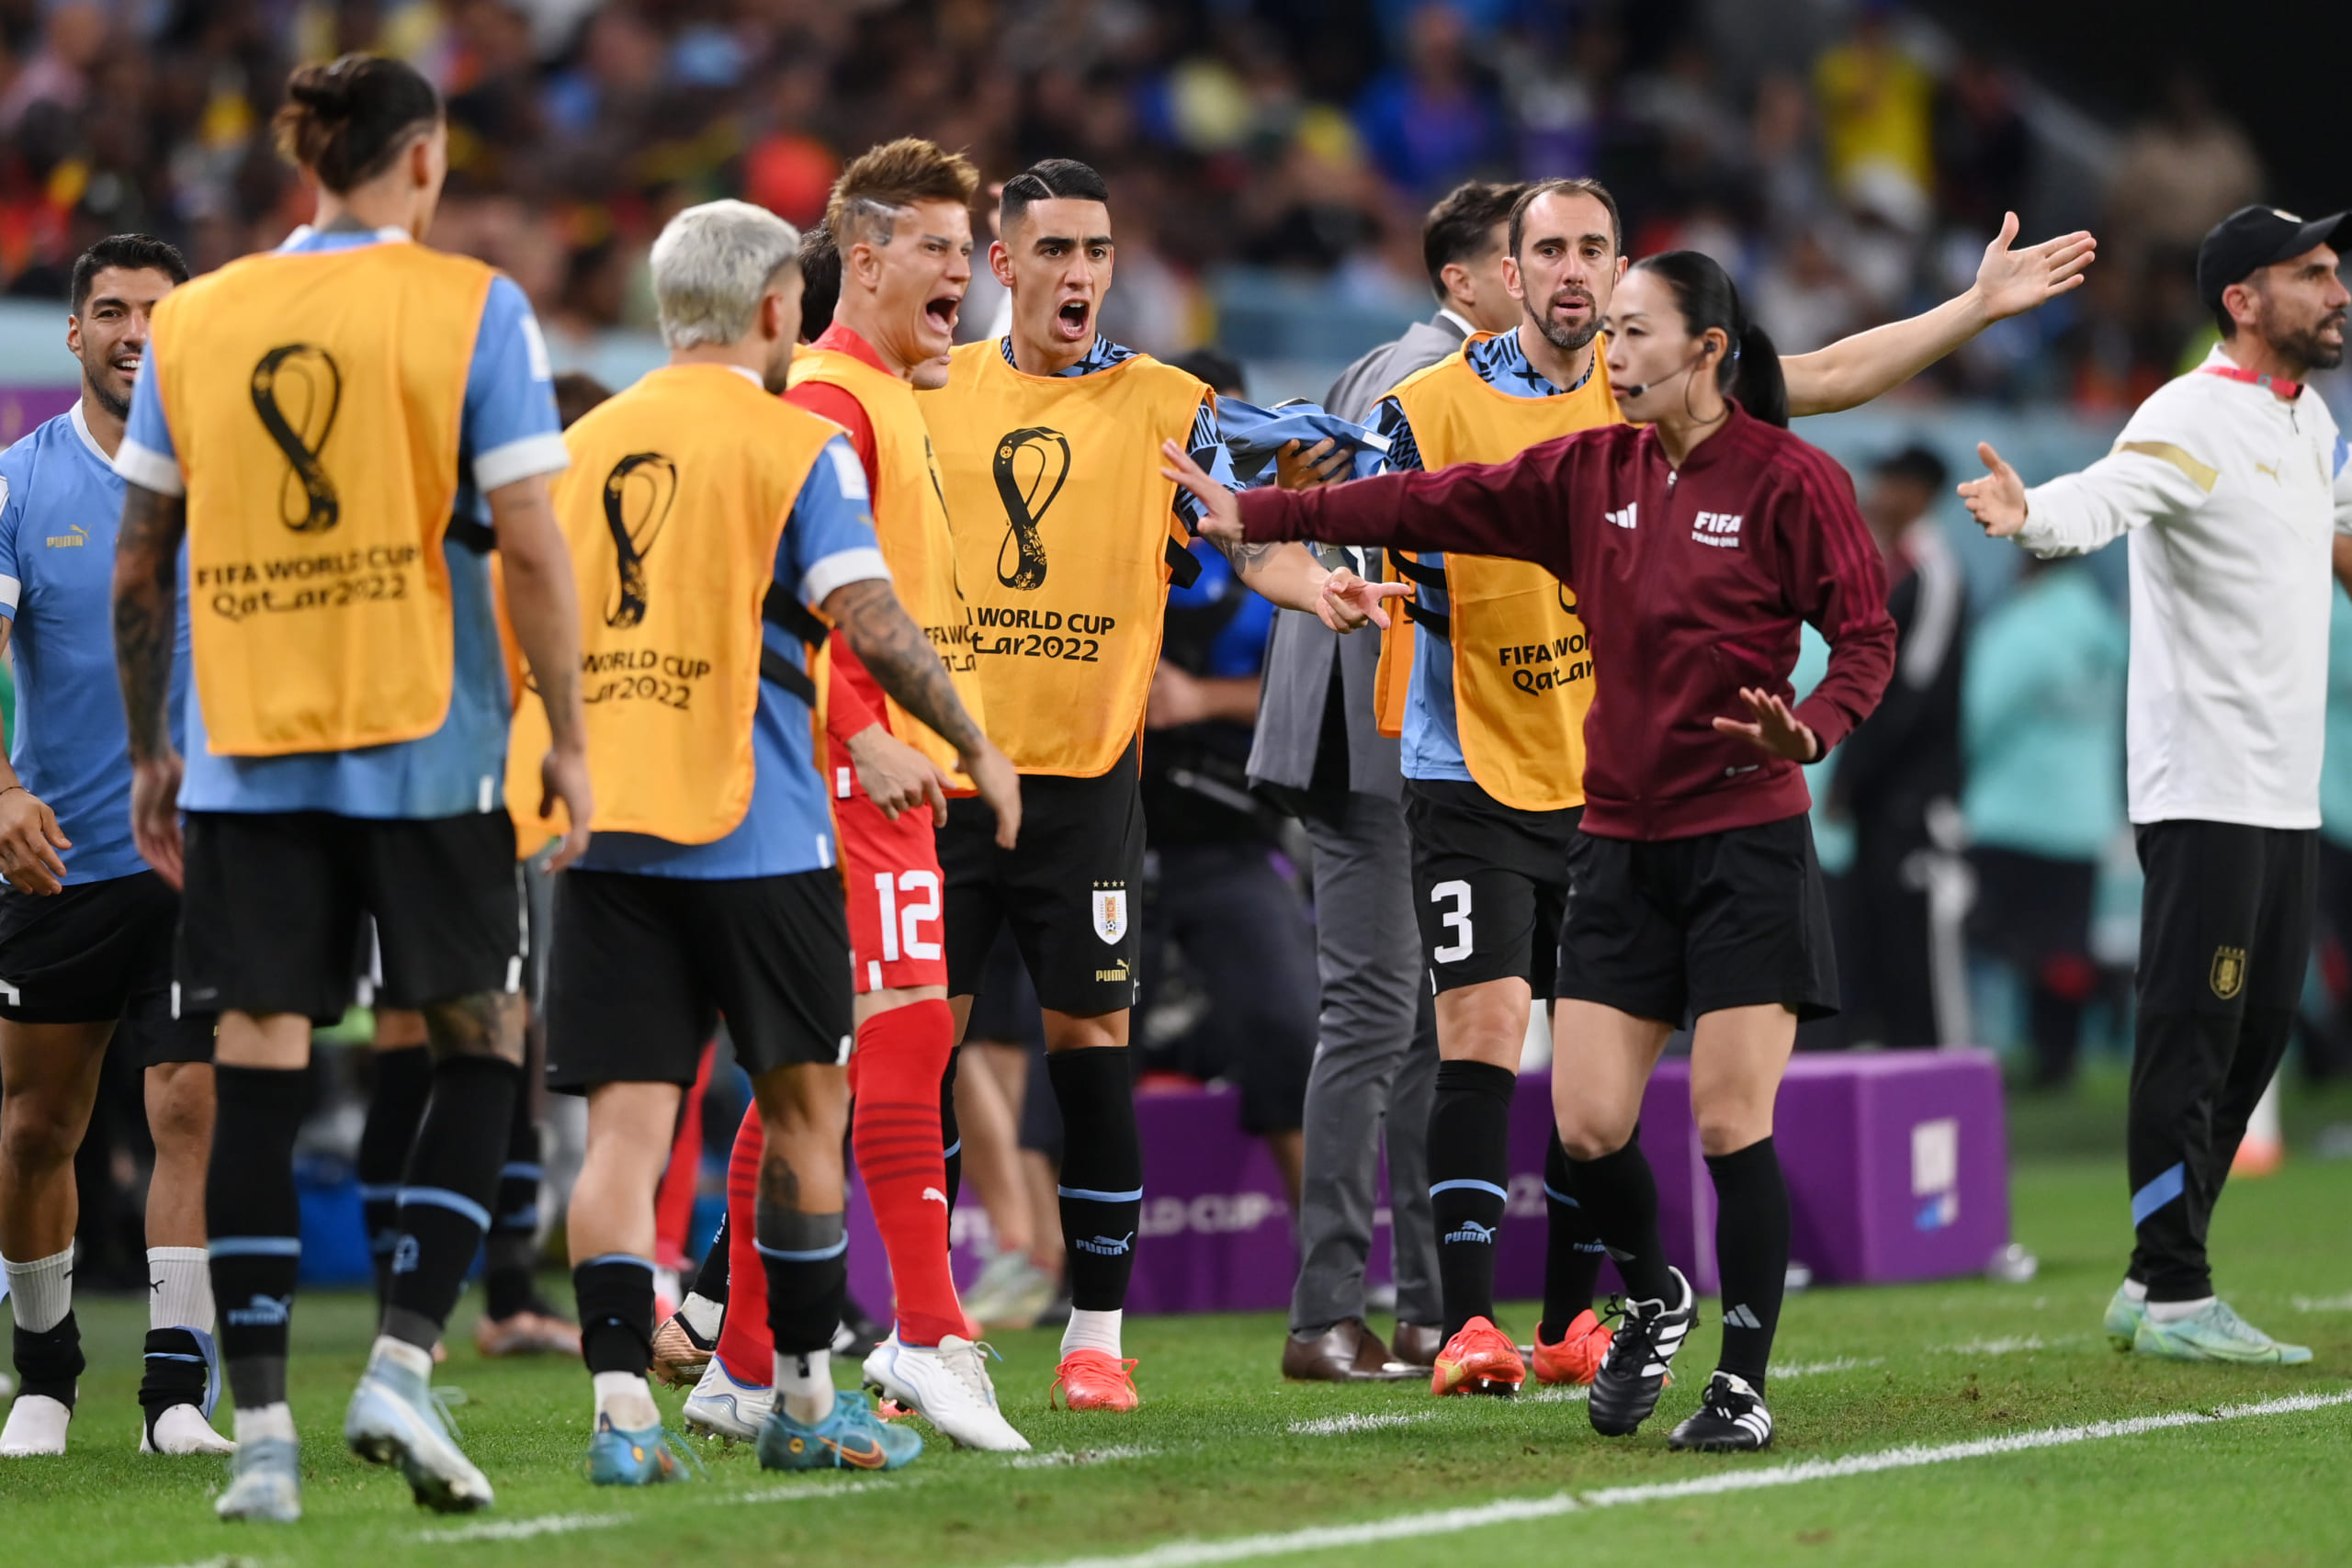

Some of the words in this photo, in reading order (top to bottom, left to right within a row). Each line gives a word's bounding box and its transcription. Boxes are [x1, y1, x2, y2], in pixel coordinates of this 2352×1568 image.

[1693, 511, 1742, 533] FIFA
[197, 563, 257, 587] FIFA
[265, 548, 360, 581] WORLD
[368, 547, 416, 569] CUP
[977, 607, 1062, 630] WORLD
[1068, 614, 1115, 636] CUP
[973, 631, 1099, 662] tar2022
[1499, 644, 1553, 666] FIFA
[581, 649, 658, 673] WORLD
[662, 656, 711, 680] CUP
[1512, 660, 1593, 696] Qatar
[875, 870, 941, 962] 12
[1430, 879, 1473, 964] 3
[1096, 969, 1126, 982] PUMA
[1076, 1238, 1123, 1256] PUMA
[1445, 1231, 1487, 1245] PUMA
